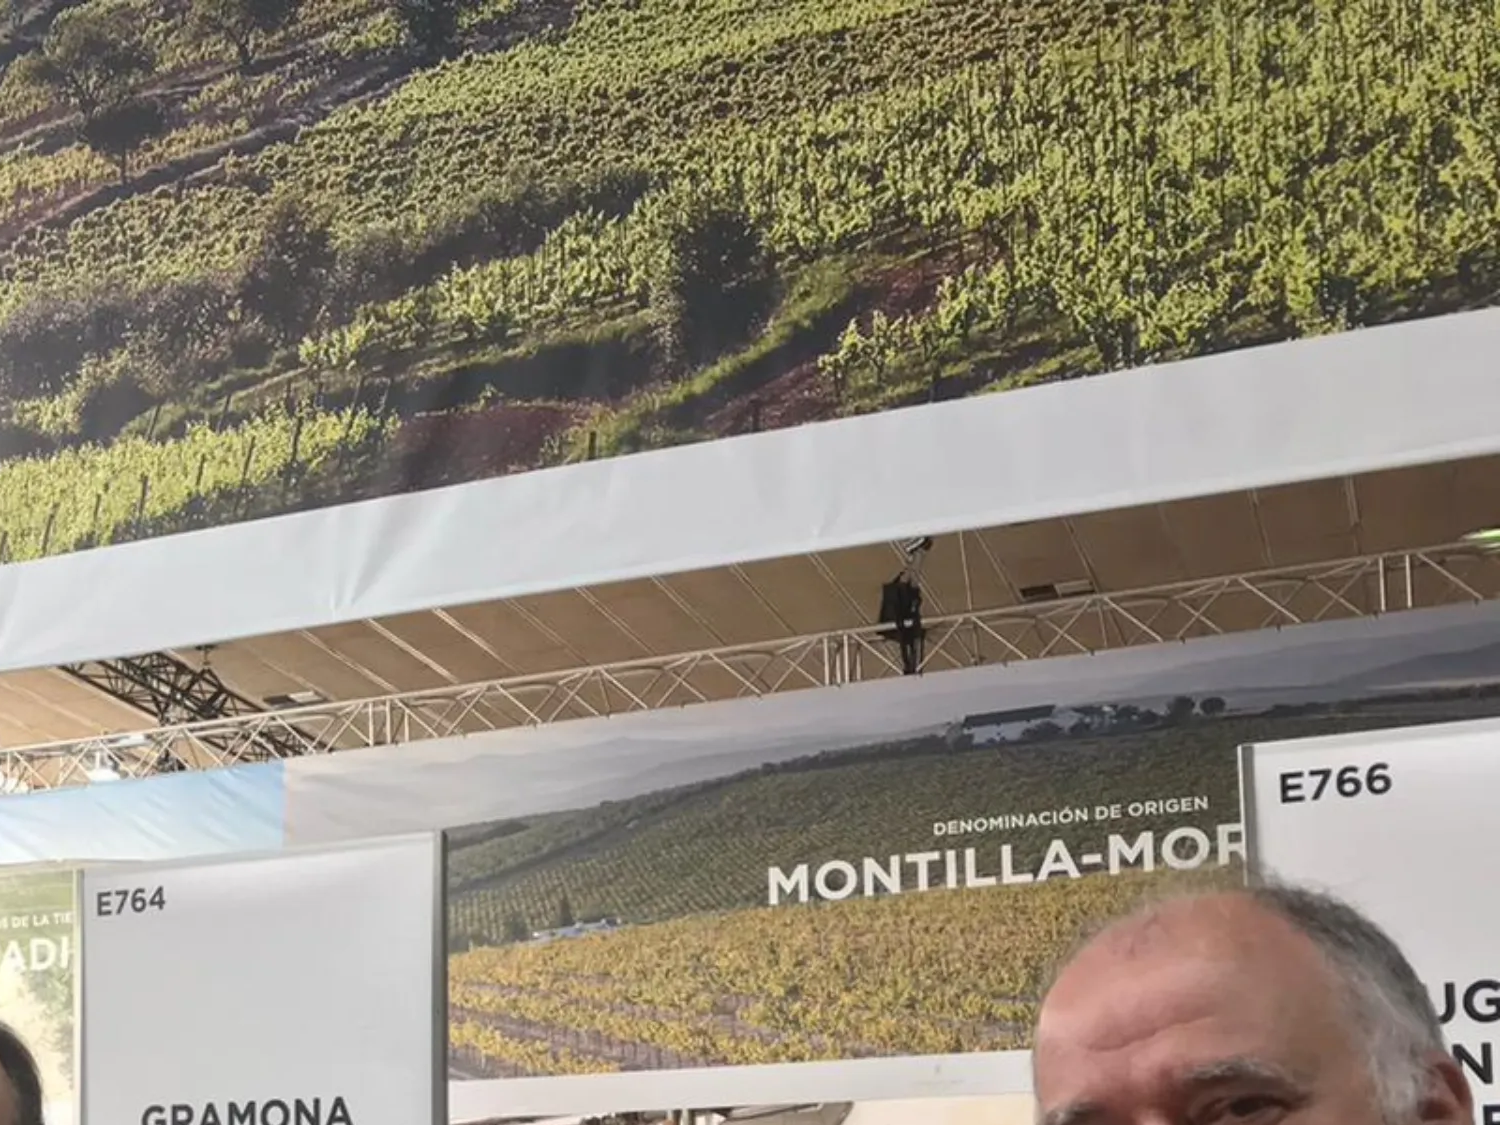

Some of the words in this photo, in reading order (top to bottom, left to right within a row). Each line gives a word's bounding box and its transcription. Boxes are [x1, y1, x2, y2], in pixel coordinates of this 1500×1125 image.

[1280, 763, 1392, 804] E766
[933, 805, 1089, 836] DENOMINACIÓN
[1095, 803, 1122, 820] DE
[1128, 796, 1209, 818] ORIGEN
[96, 886, 166, 917] E764
[11, 915, 29, 929] DE
[33, 914, 50, 927] LA
